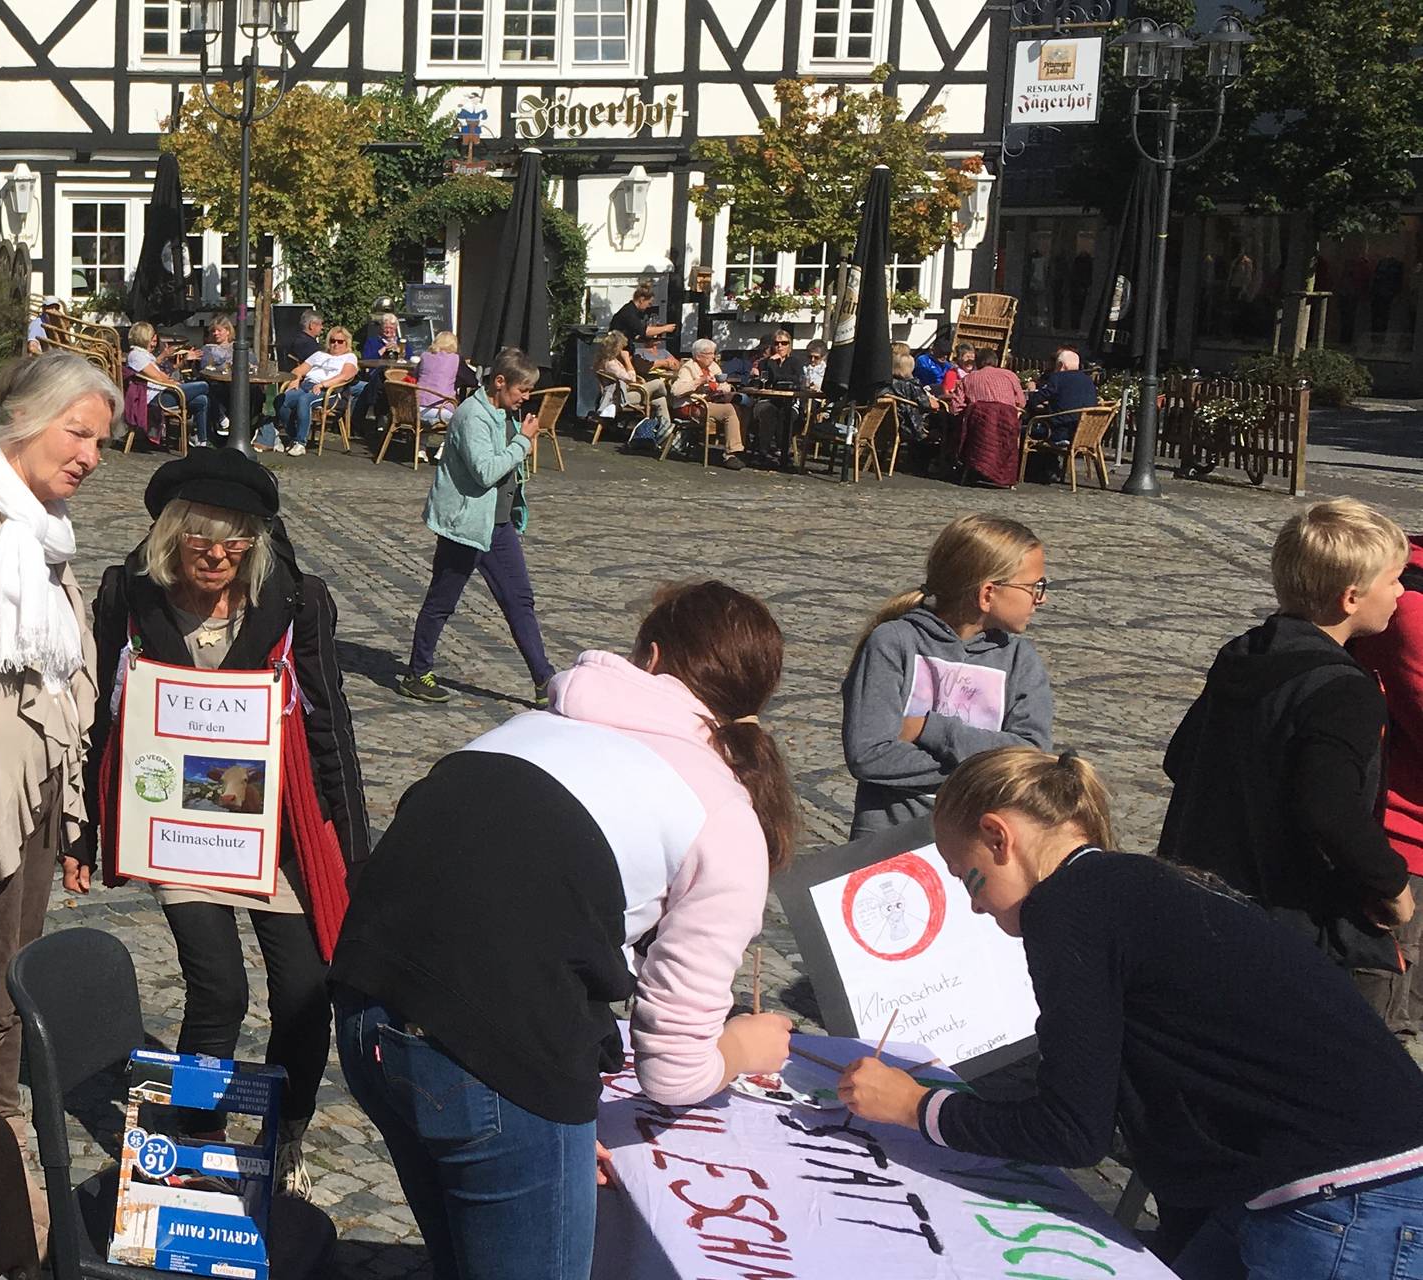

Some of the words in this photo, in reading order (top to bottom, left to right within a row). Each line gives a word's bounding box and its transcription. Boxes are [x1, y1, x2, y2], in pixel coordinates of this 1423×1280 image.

[1026, 83, 1085, 93] RESTAURANT
[1017, 92, 1093, 114] Jägerhof
[517, 91, 678, 139] Jägerhof
[166, 693, 248, 713] VEGAN
[188, 721, 205, 732] für
[206, 722, 225, 733] den
[134, 754, 146, 766] GO
[160, 828, 246, 850] Klimaschutz
[857, 972, 963, 1026] Klimaschutz
[130, 1135, 142, 1146] 36
[147, 1142, 169, 1154] PCS
[144, 1152, 167, 1172] 16
[776, 1112, 945, 1256] STATT
[168, 1222, 206, 1239] PAINT
[208, 1227, 259, 1246] ACRYLIC
